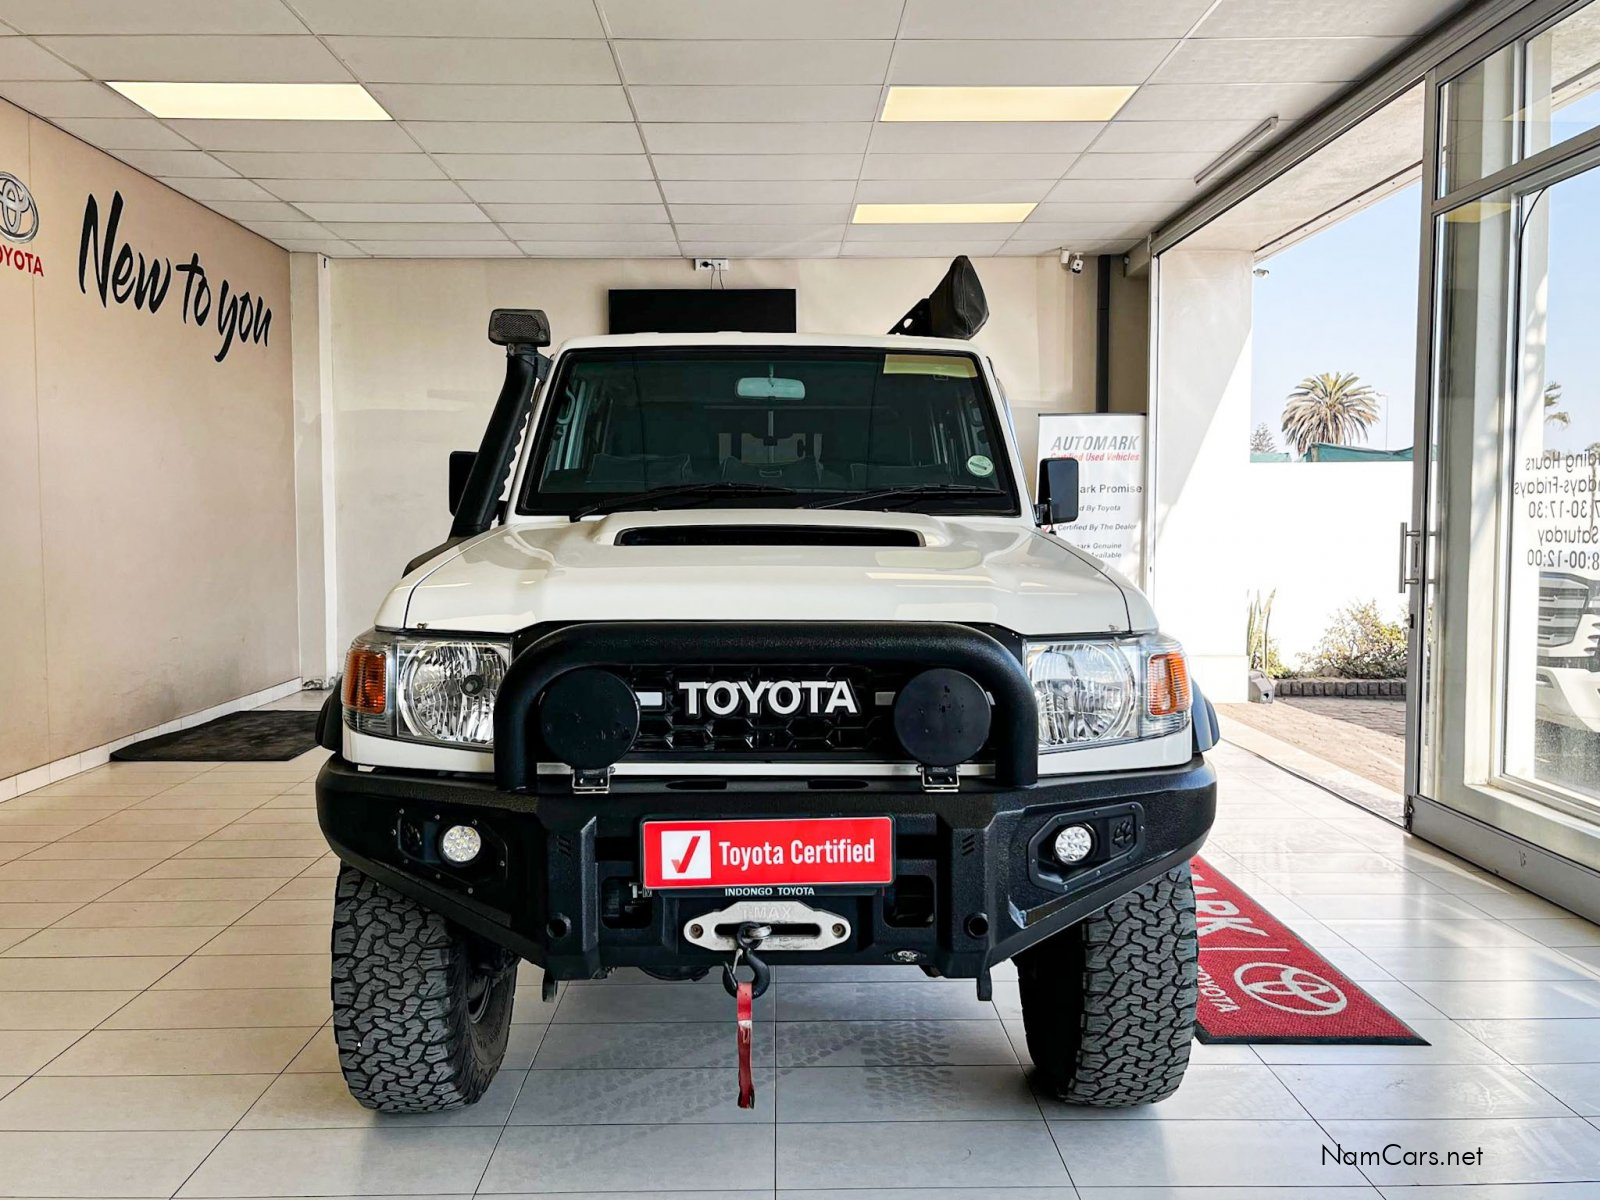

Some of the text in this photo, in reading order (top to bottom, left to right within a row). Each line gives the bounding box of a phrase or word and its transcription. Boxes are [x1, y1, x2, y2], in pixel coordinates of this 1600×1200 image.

[79, 190, 272, 363] New to you
[1050, 435, 1140, 451] AUTOMARK
[1085, 452, 1104, 461] Used
[1106, 452, 1140, 461] Vehicles
[1079, 484, 1142, 494] ark Promise
[1097, 504, 1121, 512] Toyota
[1057, 523, 1088, 531] Certified
[1089, 523, 1098, 532] By
[678, 680, 858, 715] TOYOTA
[718, 838, 876, 872] Toyota Certified
[724, 887, 816, 897] INDONGO TOYOTA
[1198, 965, 1241, 1013] OYOTA
